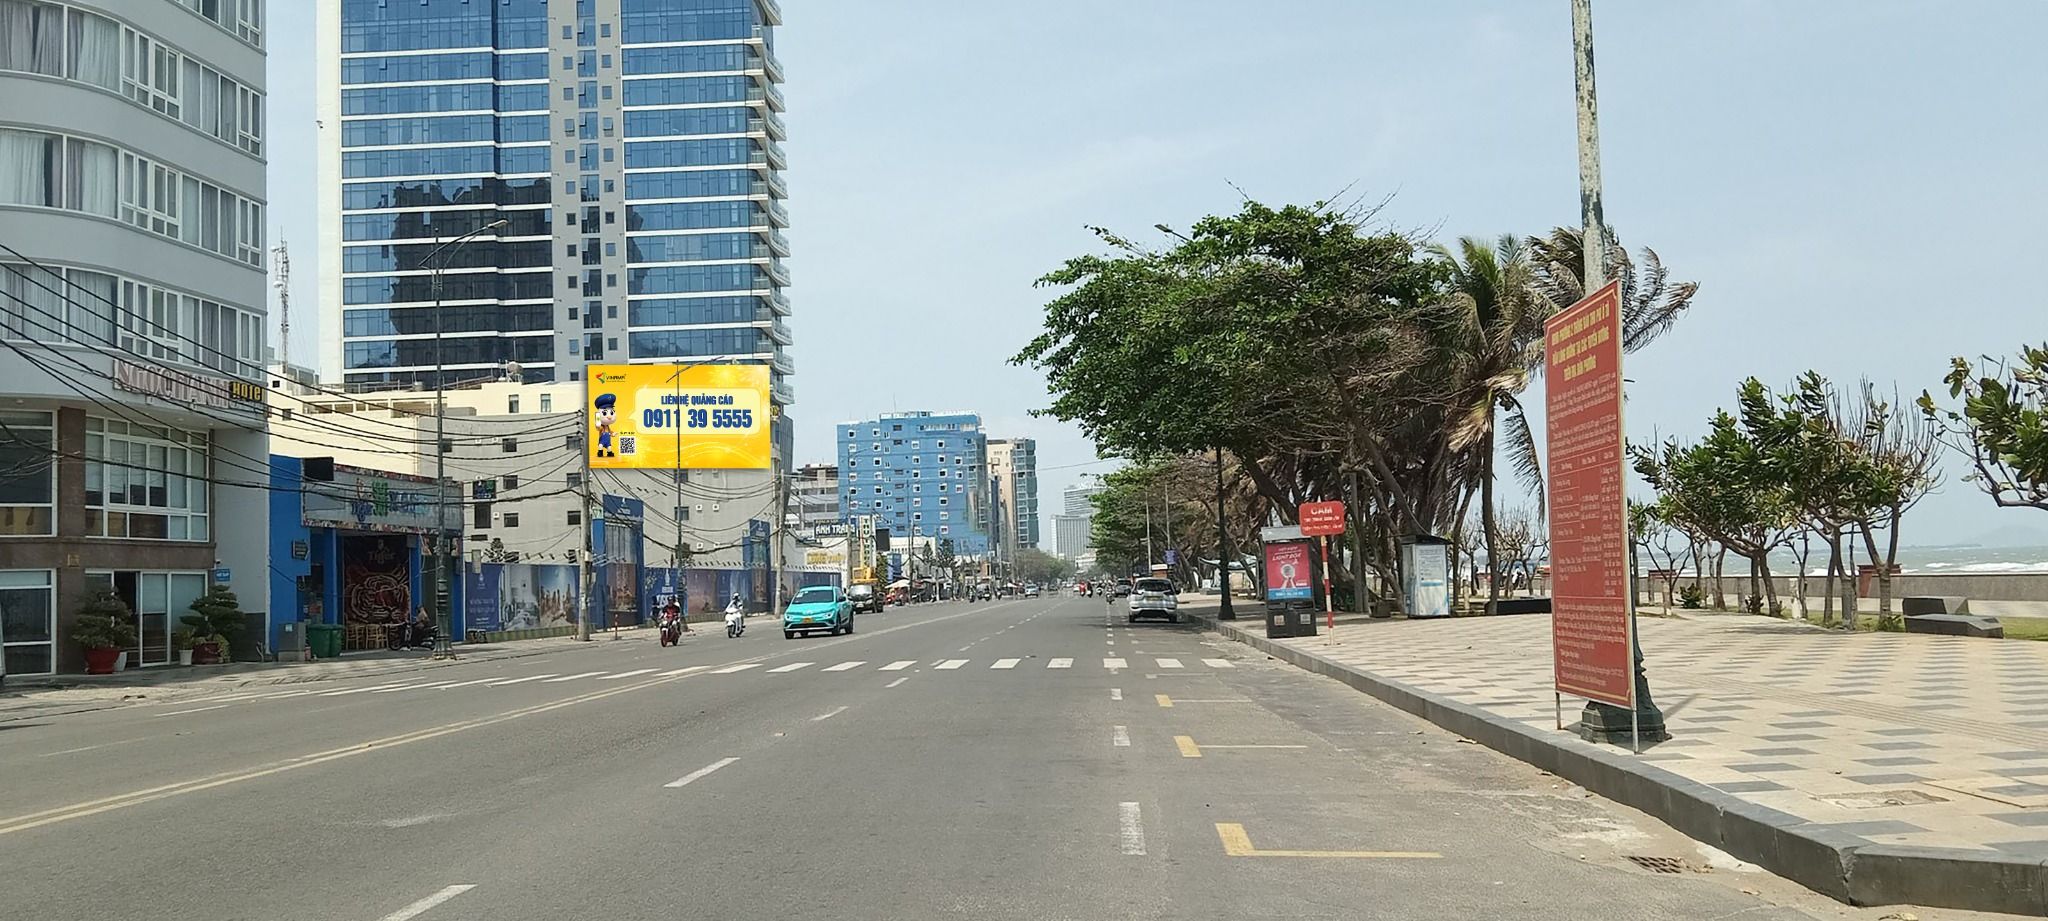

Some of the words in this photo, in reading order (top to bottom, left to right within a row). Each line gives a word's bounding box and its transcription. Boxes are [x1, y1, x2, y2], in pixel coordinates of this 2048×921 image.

[661, 394, 679, 405] LIÊN
[679, 394, 689, 407] HỆ
[691, 393, 716, 406] QUẢNG
[718, 394, 734, 405] CÁO
[644, 408, 680, 428] 0911
[688, 408, 708, 428] 39
[712, 409, 752, 428] 5555
